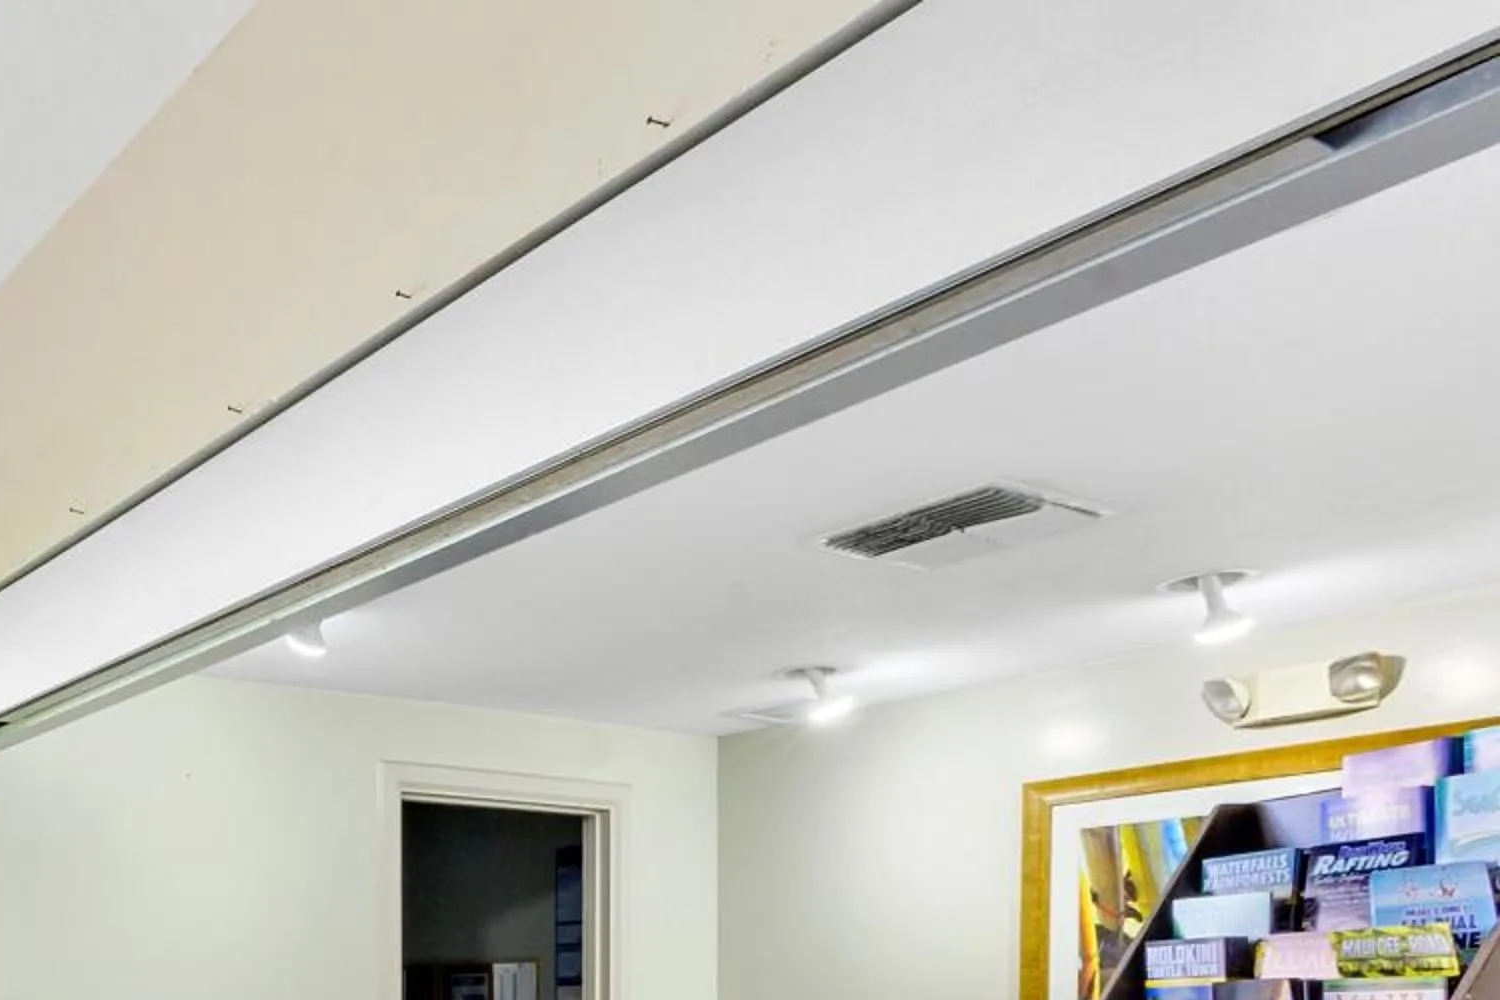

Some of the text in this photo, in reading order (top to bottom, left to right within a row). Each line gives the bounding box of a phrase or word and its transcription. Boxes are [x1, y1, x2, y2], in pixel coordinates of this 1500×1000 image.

[1313, 850, 1410, 875] RAFTING
[1147, 943, 1220, 965] MOLOKINI
[1341, 938, 1376, 957] MAUI
